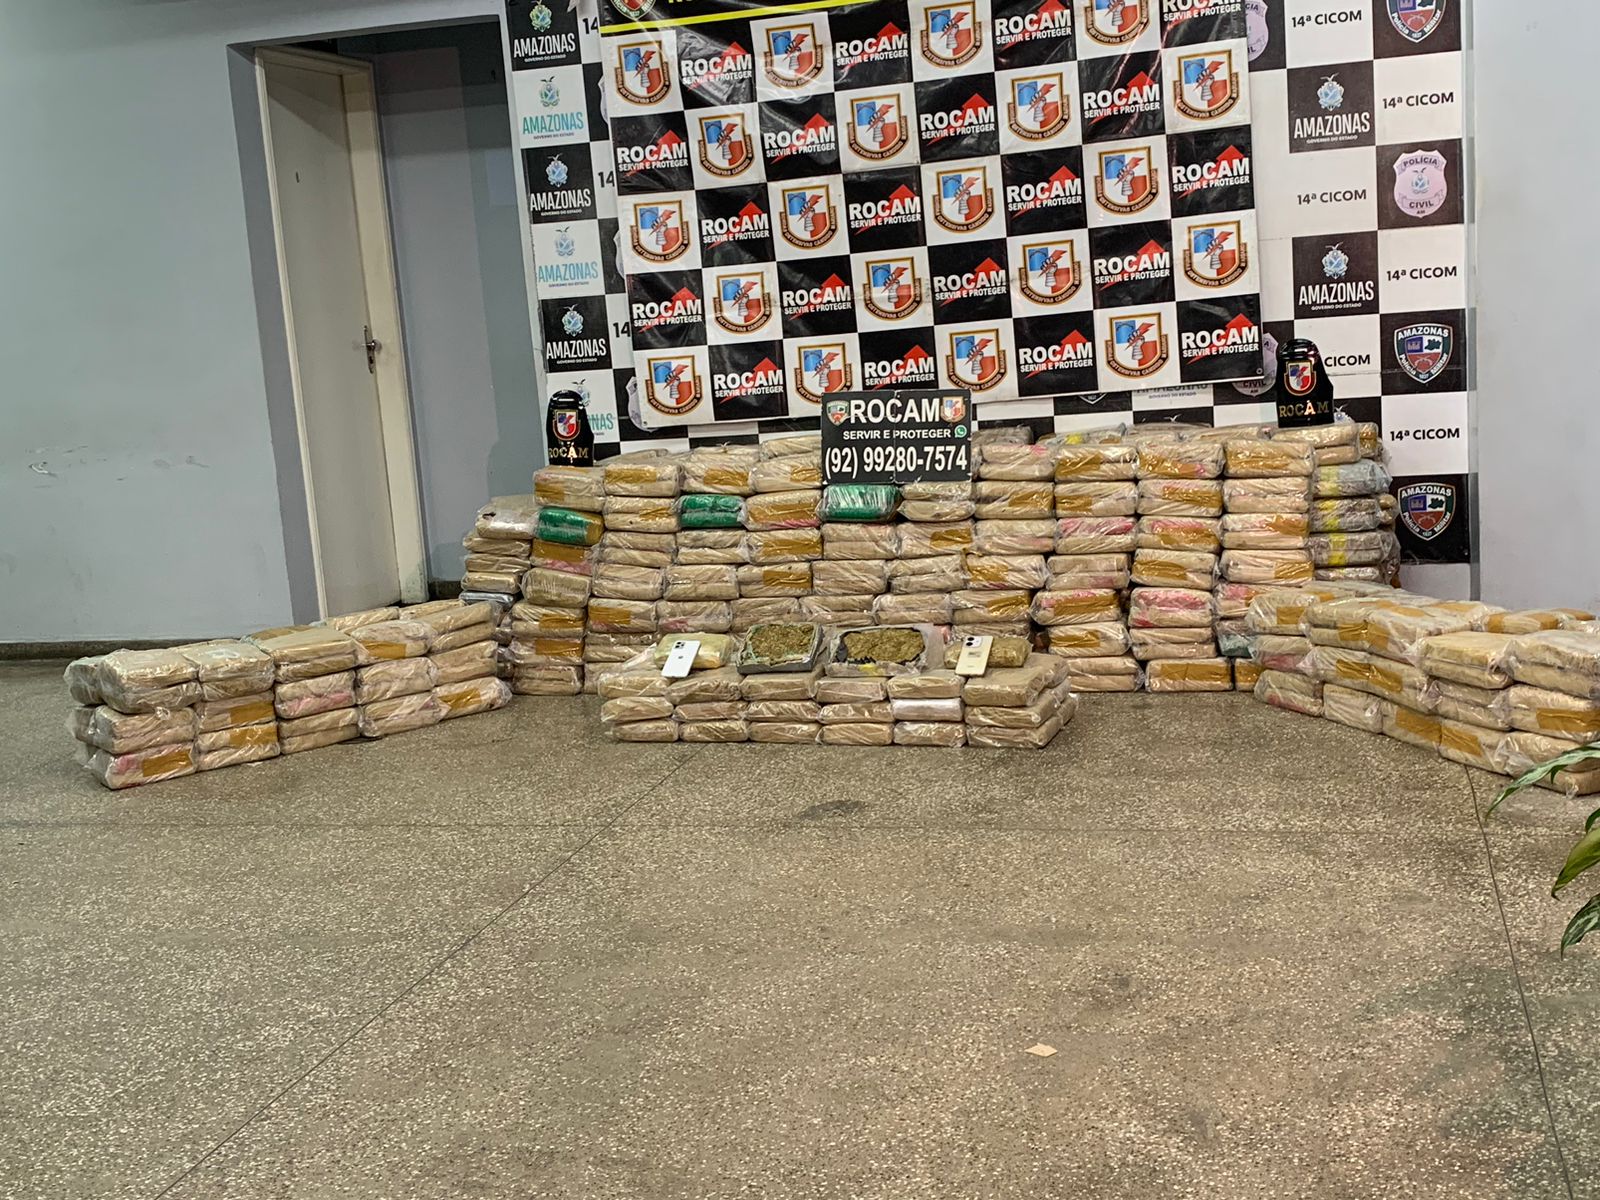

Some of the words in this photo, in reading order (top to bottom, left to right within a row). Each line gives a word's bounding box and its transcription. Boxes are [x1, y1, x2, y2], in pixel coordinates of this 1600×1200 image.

[1163, 0, 1242, 12] ROC
[1164, 10, 1191, 22] SERVIR
[1193, 9, 1199, 18] E
[1200, 4, 1241, 17] PROTEGER
[995, 9, 1071, 36] ROCAM
[1292, 16, 1311, 27] 14ª
[1315, 10, 1362, 25] CICOM
[996, 34, 1022, 44] SERVIR
[1024, 33, 1030, 41] E
[1032, 28, 1071, 40] PROTEGER
[514, 32, 575, 58] AMAZONAS
[835, 34, 908, 58] ROCAM
[681, 54, 752, 76] ROCAM
[836, 56, 862, 66] SERVIR
[864, 55, 869, 63] E
[870, 50, 908, 62] PROTEGER
[683, 75, 707, 85] SERVIR
[716, 71, 752, 82] PROTEGER
[1083, 84, 1159, 109] ROCAM
[1383, 97, 1402, 109] 14ª
[1406, 92, 1454, 106] CICOM
[920, 106, 994, 131] ROCAM
[1084, 107, 1111, 118] SERVIR
[1113, 106, 1118, 115] E
[1120, 102, 1160, 114] PROTEGER
[523, 112, 584, 134] AMAZONAS
[922, 128, 947, 139] SERVIR
[949, 128, 955, 136] E
[956, 123, 995, 135] PROTEGER
[1294, 112, 1370, 139] AMAZONAS
[764, 126, 835, 149] ROCAM
[617, 142, 687, 163] ROCAM
[766, 147, 790, 158] SERVIR
[792, 147, 797, 155] E
[799, 143, 835, 154] PROTEGER
[619, 162, 643, 172] SERVIR
[645, 162, 650, 170] E
[652, 159, 688, 169] PROTEGER
[1403, 156, 1437, 166] POLÍCIA
[1172, 158, 1249, 183] ROCAM
[1007, 179, 1082, 202] ROCAM
[1174, 181, 1200, 192] SERVIR
[1202, 180, 1208, 189] E
[1209, 176, 1249, 188] PROTEGER
[530, 189, 591, 211] AMAZONAS
[1008, 200, 1034, 211] SERVIR
[1036, 200, 1041, 208] E
[1043, 196, 1082, 207] PROTEGER
[1297, 193, 1316, 205] 14ª
[1321, 190, 1366, 203] CICOM
[850, 197, 920, 220] ROCAM
[702, 213, 768, 235] ROCAM
[851, 218, 876, 228] SERVIR
[877, 217, 883, 226] E
[884, 213, 921, 225] PROTEGER
[703, 234, 726, 243] SERVIR
[734, 230, 769, 240] PROTEGER
[538, 261, 598, 282] AMAZONAS
[1094, 252, 1170, 276] ROCAM
[933, 270, 1006, 292] ROCAM
[1095, 273, 1121, 284] SERVIR
[1123, 273, 1129, 281] E
[1130, 269, 1170, 280] PROTEGER
[1387, 270, 1406, 281] 14ª
[1410, 266, 1457, 279] CICOM
[782, 286, 850, 306] ROCAM
[935, 290, 960, 300] SERVIR
[962, 289, 967, 298] E
[969, 286, 1006, 297] PROTEGER
[1299, 281, 1374, 305] AMAZONAS
[632, 299, 702, 319] ROCAM
[784, 305, 808, 315] SERVIR
[810, 304, 814, 313] E
[816, 301, 851, 312] PROTEGER
[634, 318, 658, 327] SERVIR
[660, 317, 664, 325] E
[666, 314, 702, 324] PROTEGER
[1181, 326, 1259, 349] ROCAM
[1398, 327, 1449, 340] AMAZONAS
[547, 338, 606, 359] AMAZONAS
[1019, 342, 1092, 364] ROCAM
[1183, 348, 1210, 358] SERVIR
[1212, 347, 1217, 355] E
[1219, 343, 1259, 354] PROTEGER
[864, 357, 934, 378] ROCAM
[1020, 362, 1046, 372] SERVIR
[1048, 362, 1053, 370] E
[1055, 358, 1093, 369] PROTEGER
[1325, 354, 1370, 367] CICOM
[713, 370, 783, 390] ROCAM
[866, 376, 890, 386] SERVIR
[898, 373, 934, 383] PROTEGER
[715, 388, 739, 398] SERVIR
[741, 388, 746, 396] E
[748, 384, 783, 395] PROTEGER
[851, 398, 939, 423] ROCAM
[1279, 401, 1329, 417] ROCAM
[843, 430, 880, 440] SERVIR
[883, 431, 890, 439] E
[893, 429, 951, 439] PROTEGER
[1390, 430, 1410, 441] 14ª
[1413, 428, 1459, 440] CICOM
[825, 448, 858, 479] (92)
[864, 445, 967, 472] 99280-7574
[1402, 486, 1451, 498] AMAZONAS
